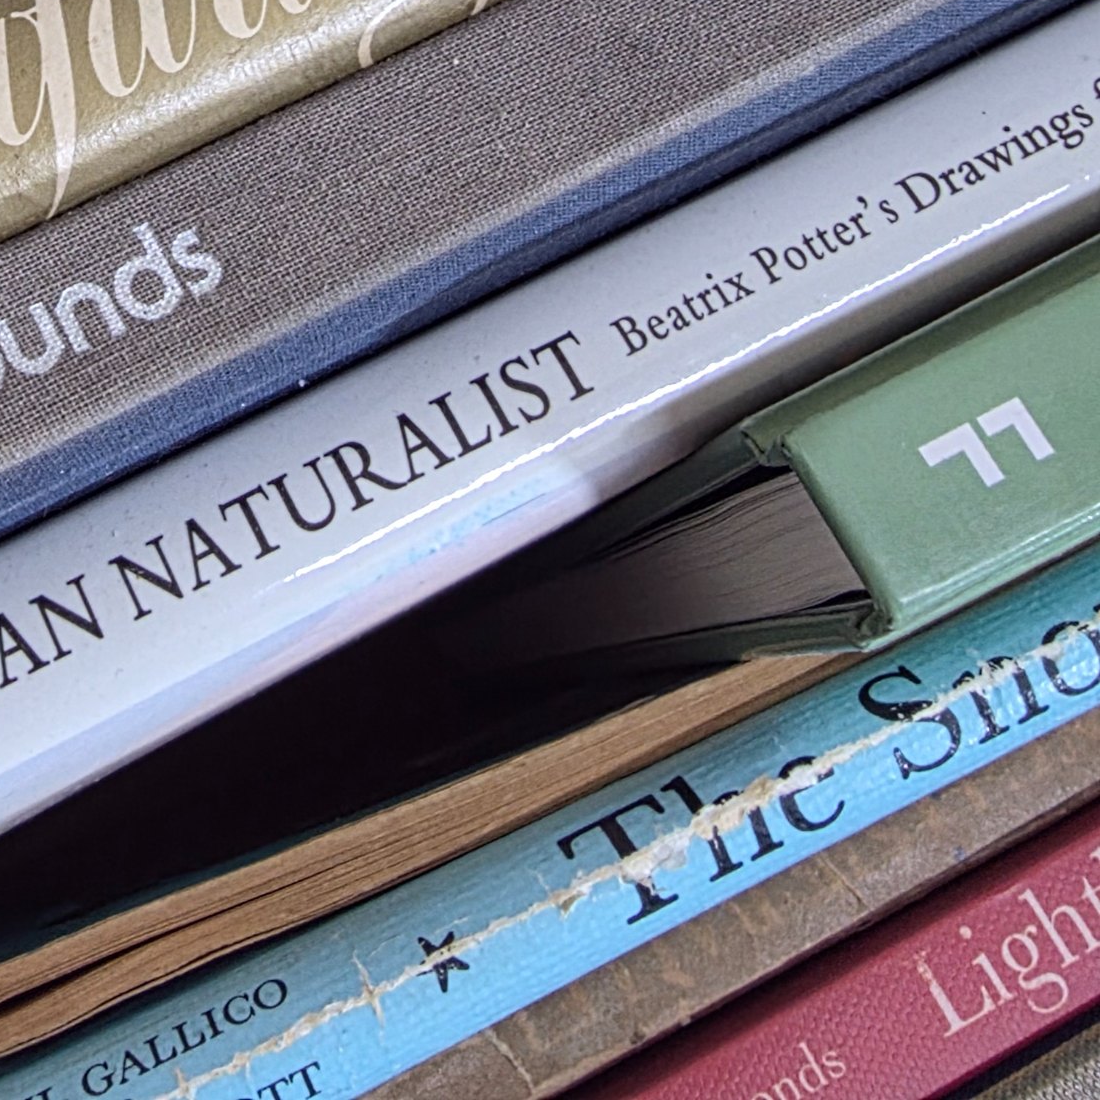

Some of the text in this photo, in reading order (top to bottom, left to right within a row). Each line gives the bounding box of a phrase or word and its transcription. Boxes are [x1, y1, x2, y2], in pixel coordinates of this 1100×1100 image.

[109, 331, 595, 621] NATURALIST
[609, 272, 755, 356] Beatrix
[750, 195, 899, 285] Potter's
[895, 104, 1094, 214] Drawings
[557, 603, 1100, 925] The Sno
[81, 979, 288, 1097] GALLICO
